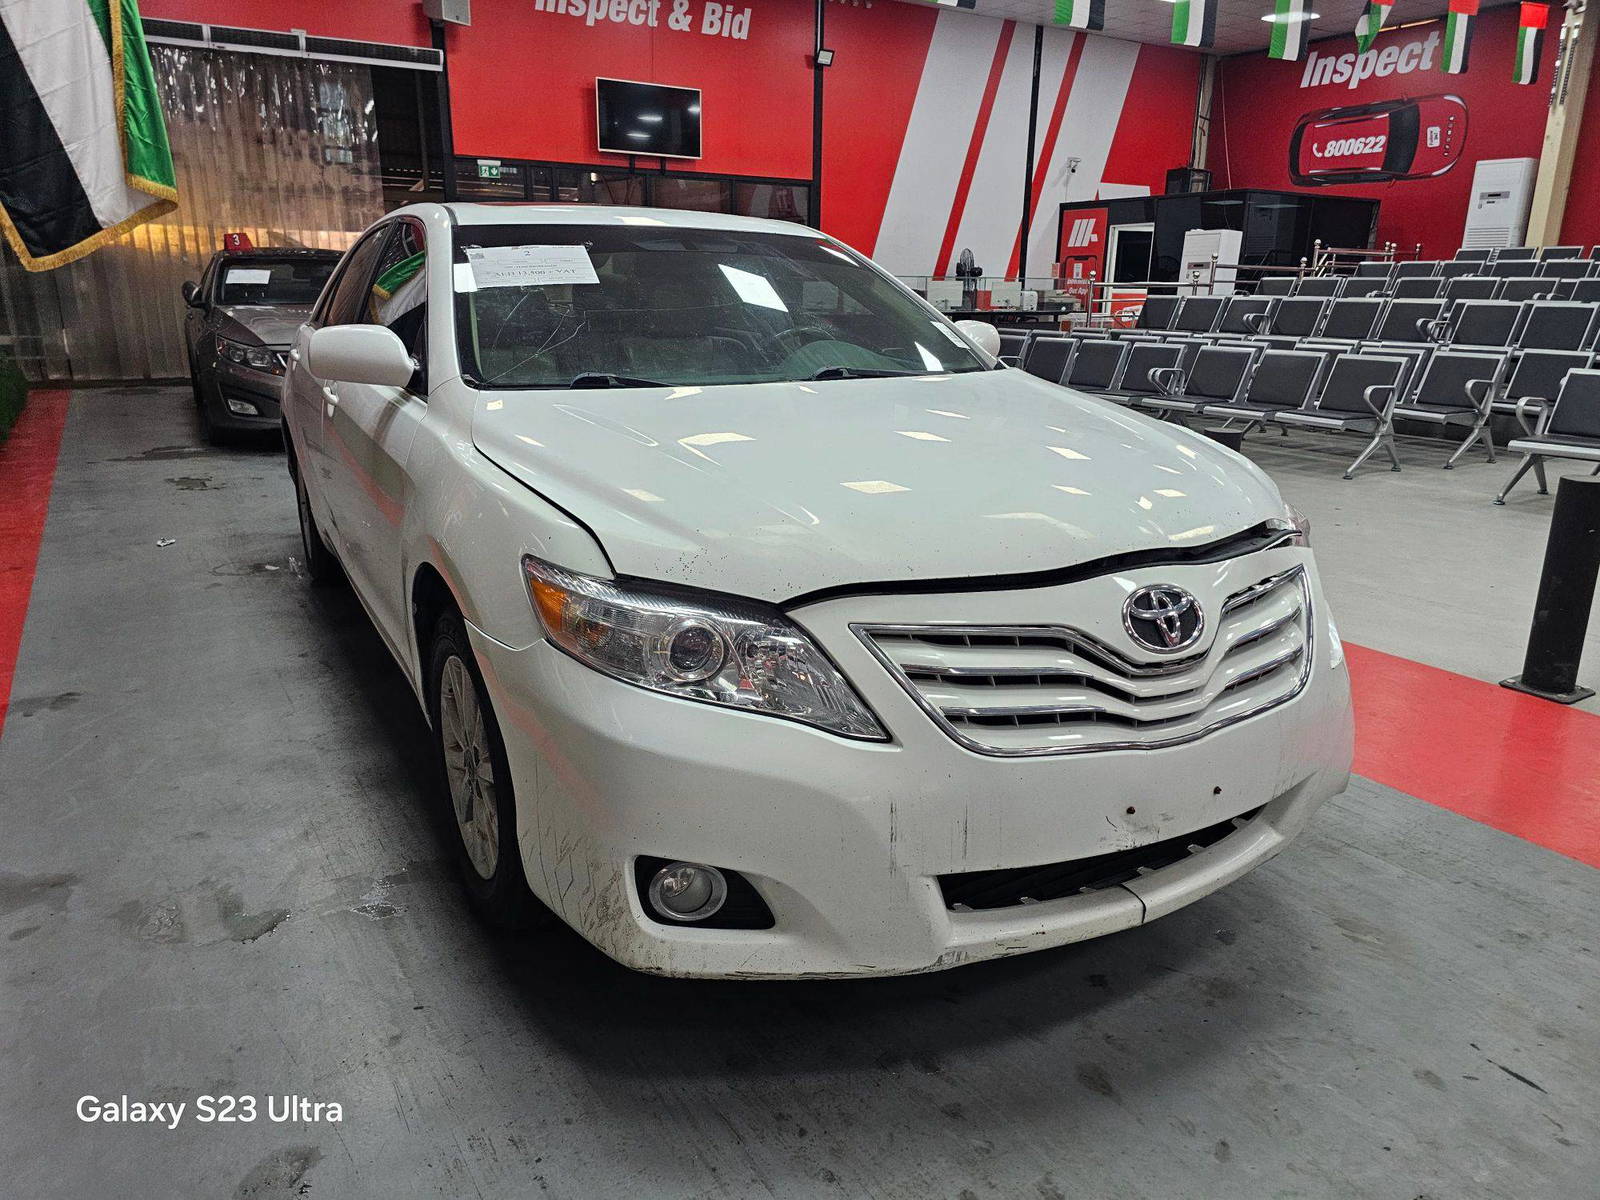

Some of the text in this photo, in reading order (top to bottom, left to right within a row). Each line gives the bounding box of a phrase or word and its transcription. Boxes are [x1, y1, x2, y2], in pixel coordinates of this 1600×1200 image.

[667, 0, 693, 32] &
[701, 1, 752, 40] Bid
[1300, 31, 1441, 90] Inspect
[1323, 135, 1387, 158] 800622
[233, 234, 240, 246] 3
